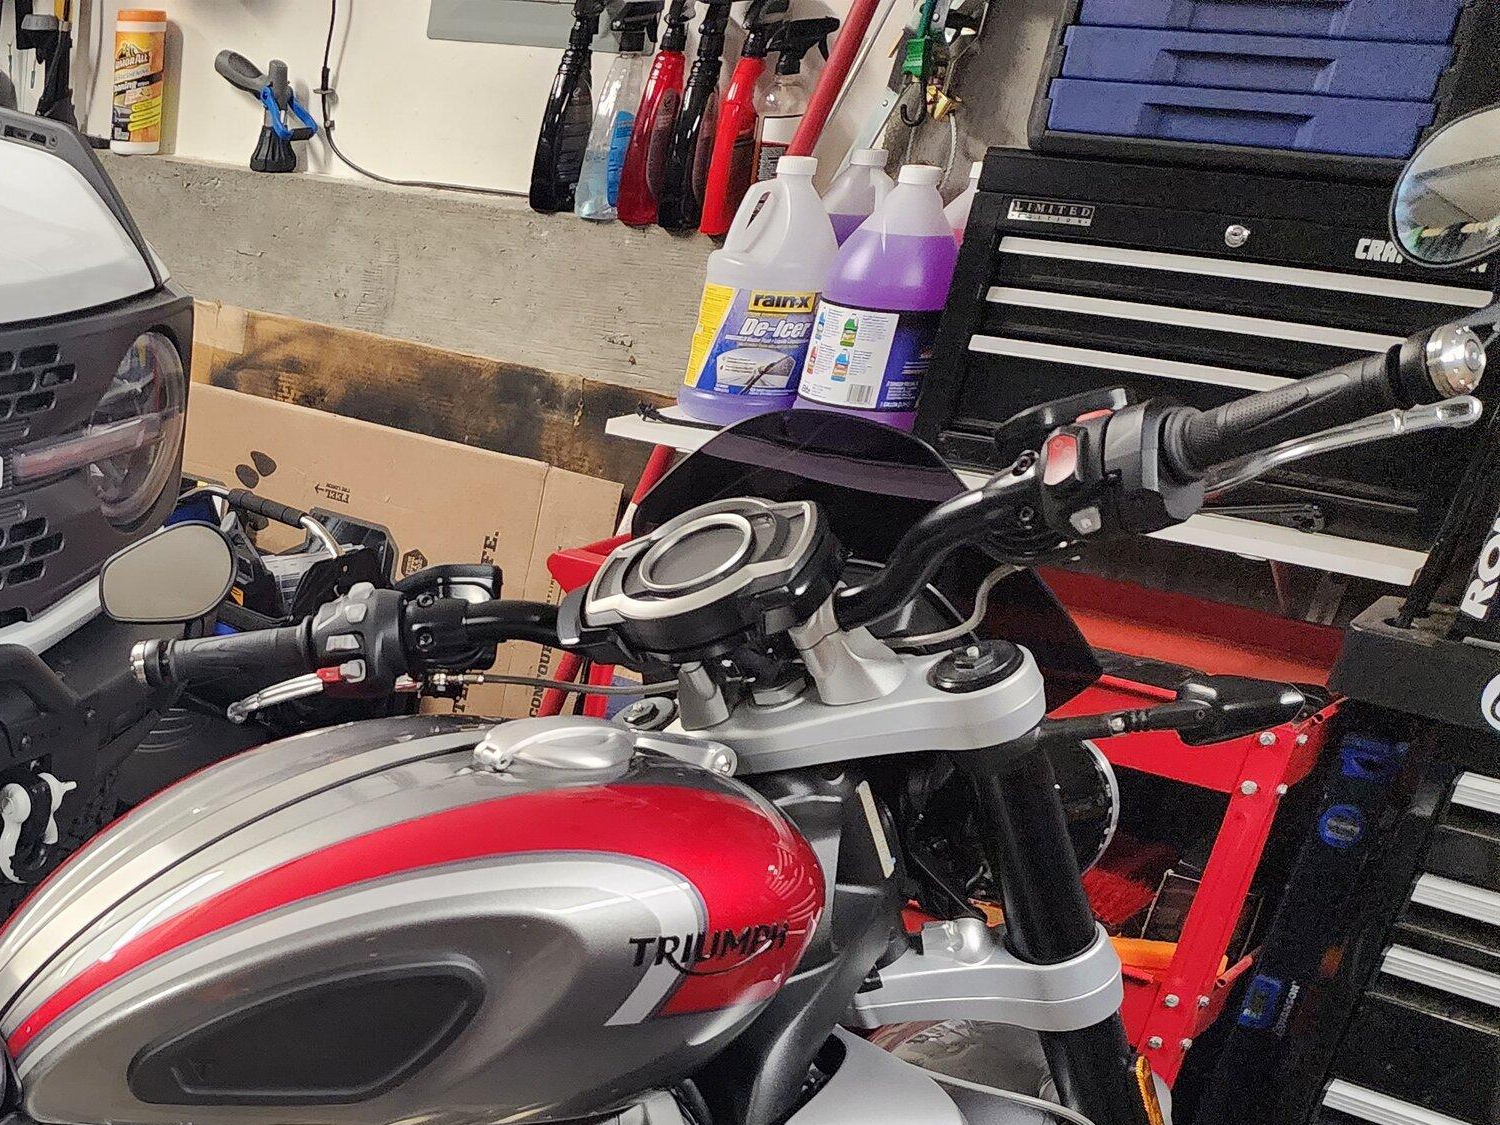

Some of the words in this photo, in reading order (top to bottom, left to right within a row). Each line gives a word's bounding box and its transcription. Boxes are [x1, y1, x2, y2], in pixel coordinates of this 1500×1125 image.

[1014, 201, 1091, 217] LIMITED
[739, 317, 813, 338] De-Icer
[325, 489, 350, 504] FEEL
[1460, 517, 1500, 620] RO
[529, 644, 553, 718] CONOUR
[628, 920, 790, 974] TRIUMPH
